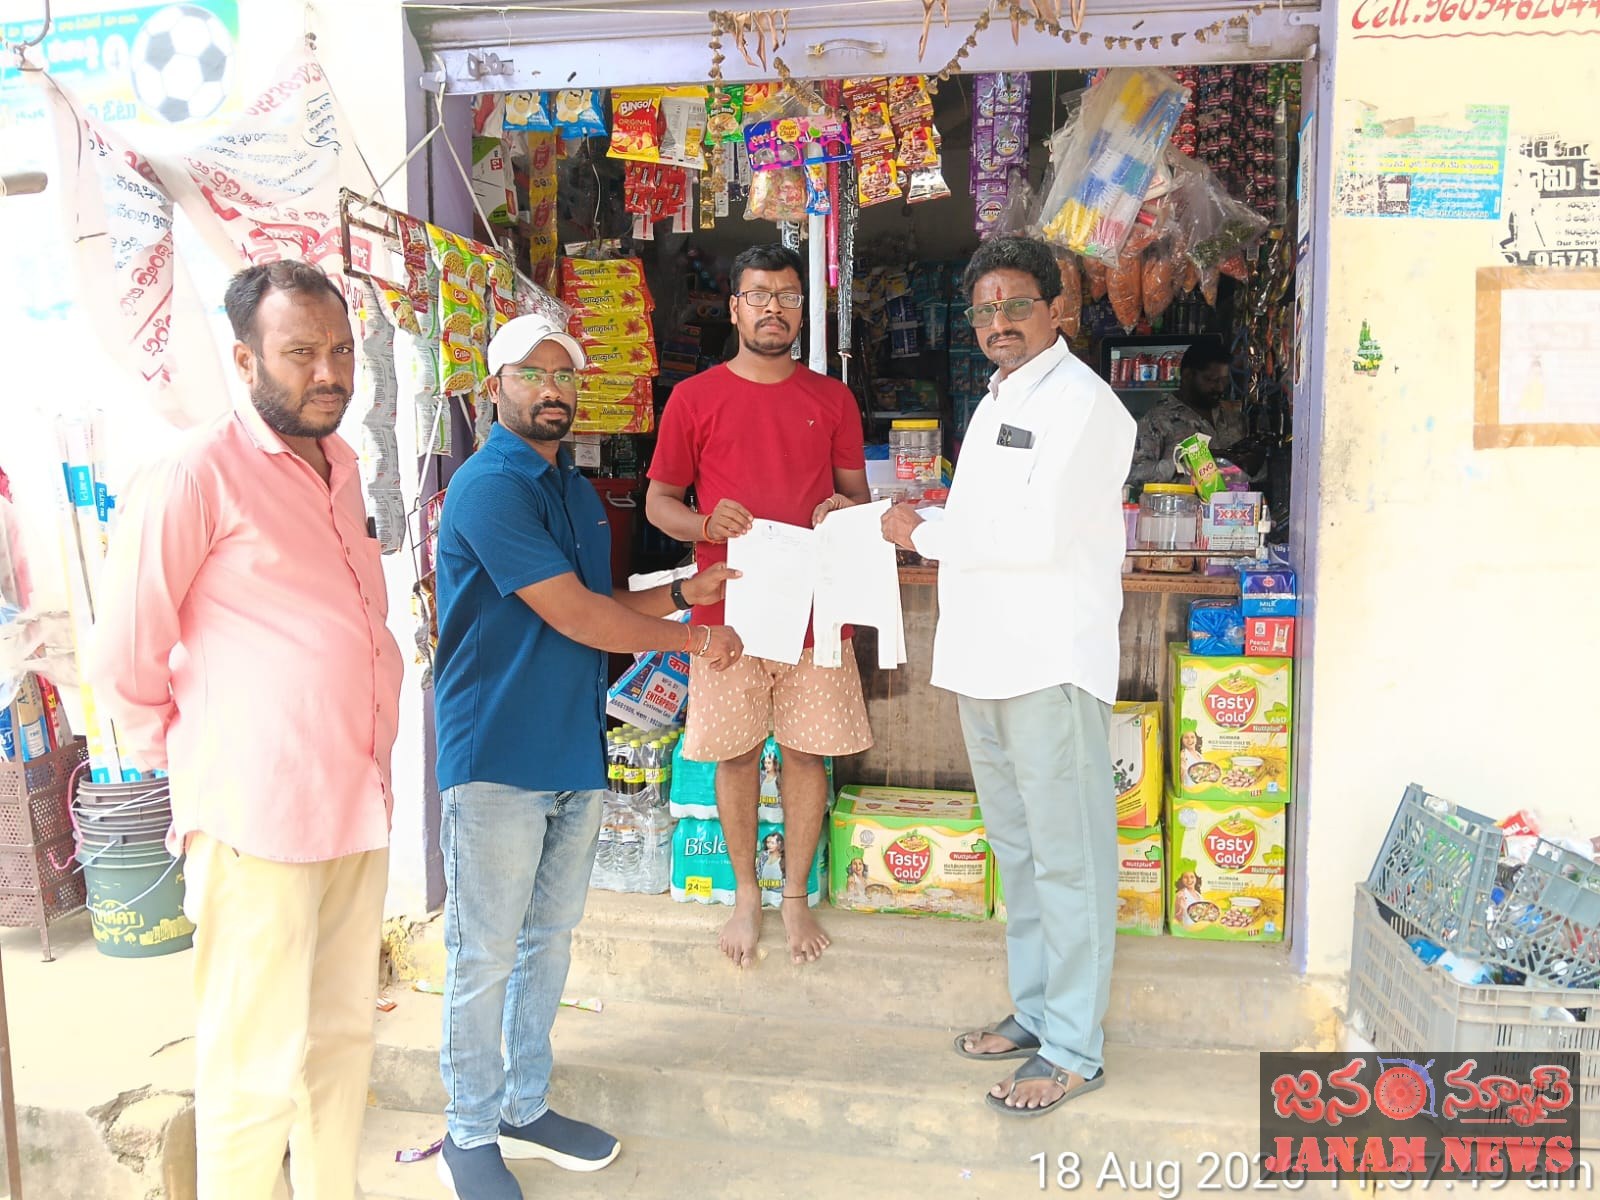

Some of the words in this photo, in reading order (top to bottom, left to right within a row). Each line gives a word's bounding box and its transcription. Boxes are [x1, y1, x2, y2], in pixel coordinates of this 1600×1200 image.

[620, 98, 653, 114] BINGO!
[1208, 694, 1255, 713] Tasty
[1215, 711, 1247, 723] Gold
[685, 836, 728, 857] Bisle
[1207, 835, 1253, 855] Tasty
[887, 851, 929, 870] Tasty
[1214, 851, 1246, 864] Gold
[893, 868, 922, 879] Gold
